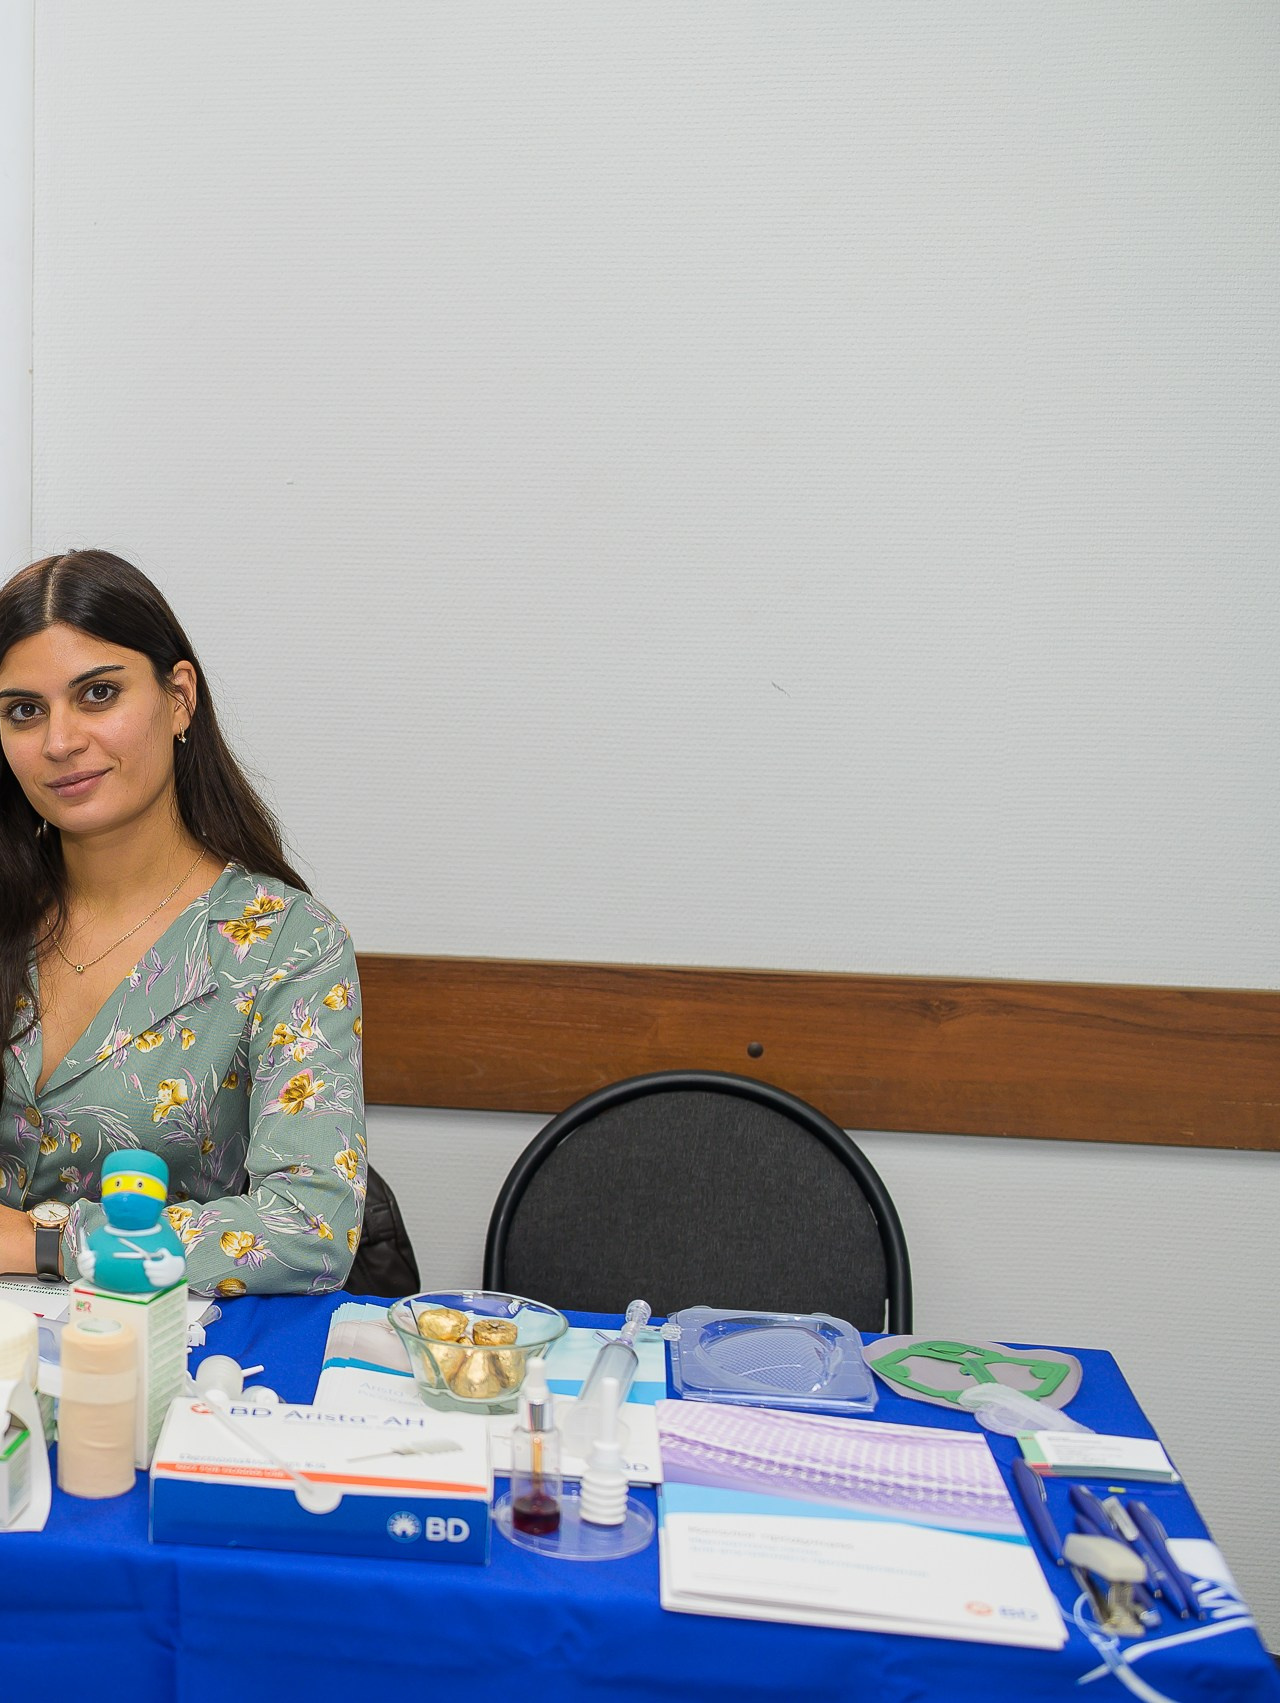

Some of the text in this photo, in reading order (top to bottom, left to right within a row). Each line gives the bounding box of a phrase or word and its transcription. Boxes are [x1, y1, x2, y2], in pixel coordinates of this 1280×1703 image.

[30, 1284, 70, 1293] ВЫСОКО
[230, 1404, 272, 1417] BD
[383, 1415, 425, 1429] AH
[424, 1516, 471, 1544] BD
